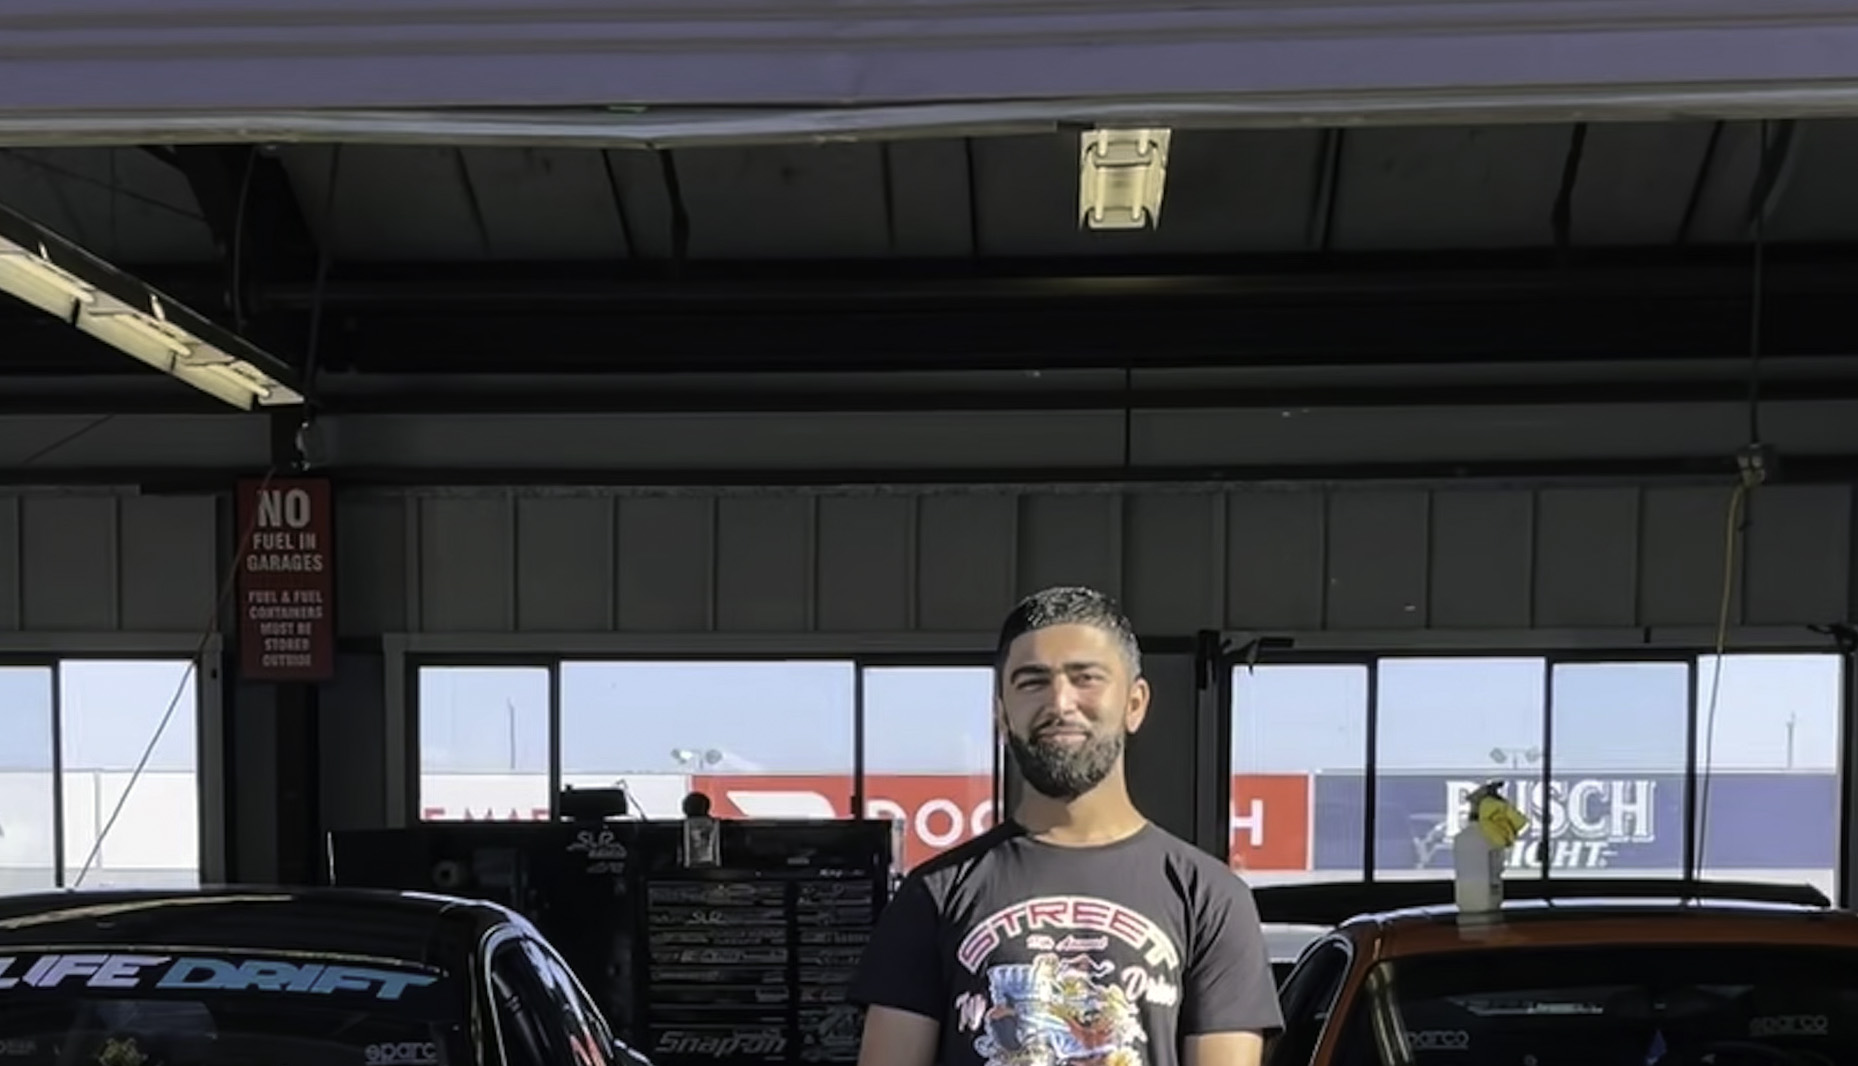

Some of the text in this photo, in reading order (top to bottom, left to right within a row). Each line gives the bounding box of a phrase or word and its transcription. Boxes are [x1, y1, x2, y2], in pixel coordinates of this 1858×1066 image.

[257, 489, 311, 528] NO
[253, 532, 317, 550] FUEL IN
[247, 554, 324, 572] GARAGES
[248, 589, 323, 604] FUEL & FUEL
[248, 605, 323, 620] CONTAINERS
[260, 621, 312, 636] MUST BE
[264, 637, 311, 652] STORED
[958, 895, 1179, 974] STREET
[155, 956, 439, 1000] DRIFT
[1403, 1030, 1471, 1050] parco
[364, 1042, 438, 1065] sparc
